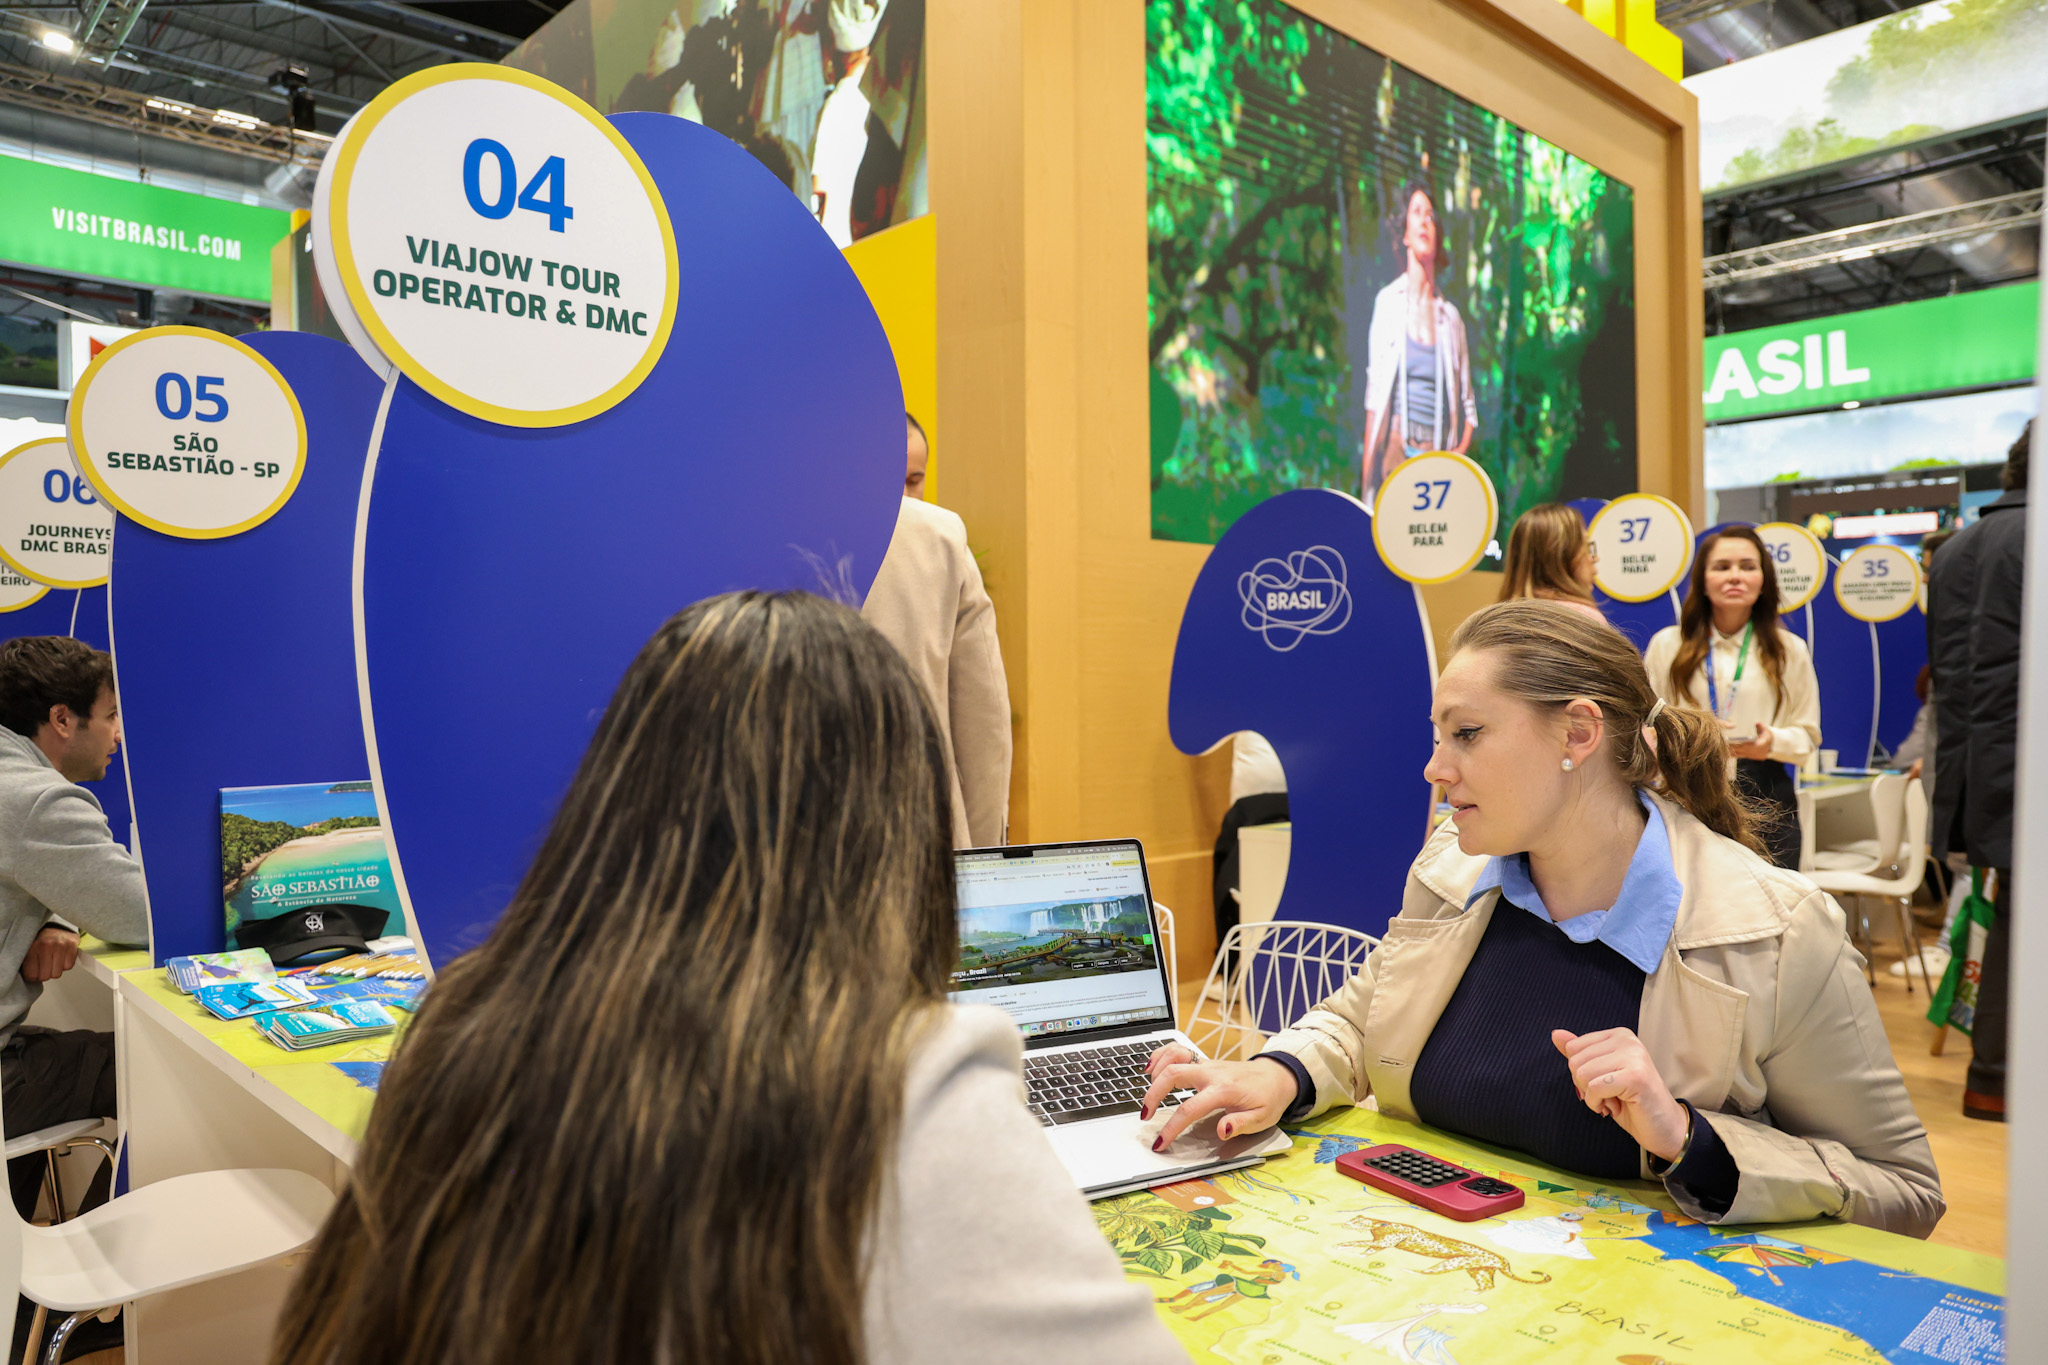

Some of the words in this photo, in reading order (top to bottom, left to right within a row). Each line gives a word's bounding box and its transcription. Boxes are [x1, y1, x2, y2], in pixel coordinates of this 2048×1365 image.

[463, 138, 573, 233] 04
[52, 207, 241, 261] VISITBRASIL.COM
[406, 235, 533, 282] VIAJOW
[541, 260, 621, 298] TOUR
[373, 269, 547, 321] OPERATOR
[556, 299, 576, 326] &
[586, 303, 647, 336] DMC
[1703, 330, 1870, 403] ASIL
[155, 372, 229, 423] 05
[173, 432, 218, 453] SÃO
[107, 452, 234, 475] SEBASTIÃO
[254, 462, 280, 478] SP
[43, 469, 98, 505] 06
[1412, 480, 1451, 511] 37
[1620, 517, 1651, 543] 37
[21, 539, 59, 553] DMC
[64, 542, 110, 555] BRAS
[1863, 560, 1889, 578] 35
[1266, 590, 1327, 611] BRASIL
[251, 882, 287, 899] SÃO
[288, 874, 380, 895] SEBASTIÃO
[1945, 1292, 2007, 1311] EUROP
[1515, 1328, 1556, 1345] PALMAS
[1554, 1300, 1693, 1351] BRASIL
